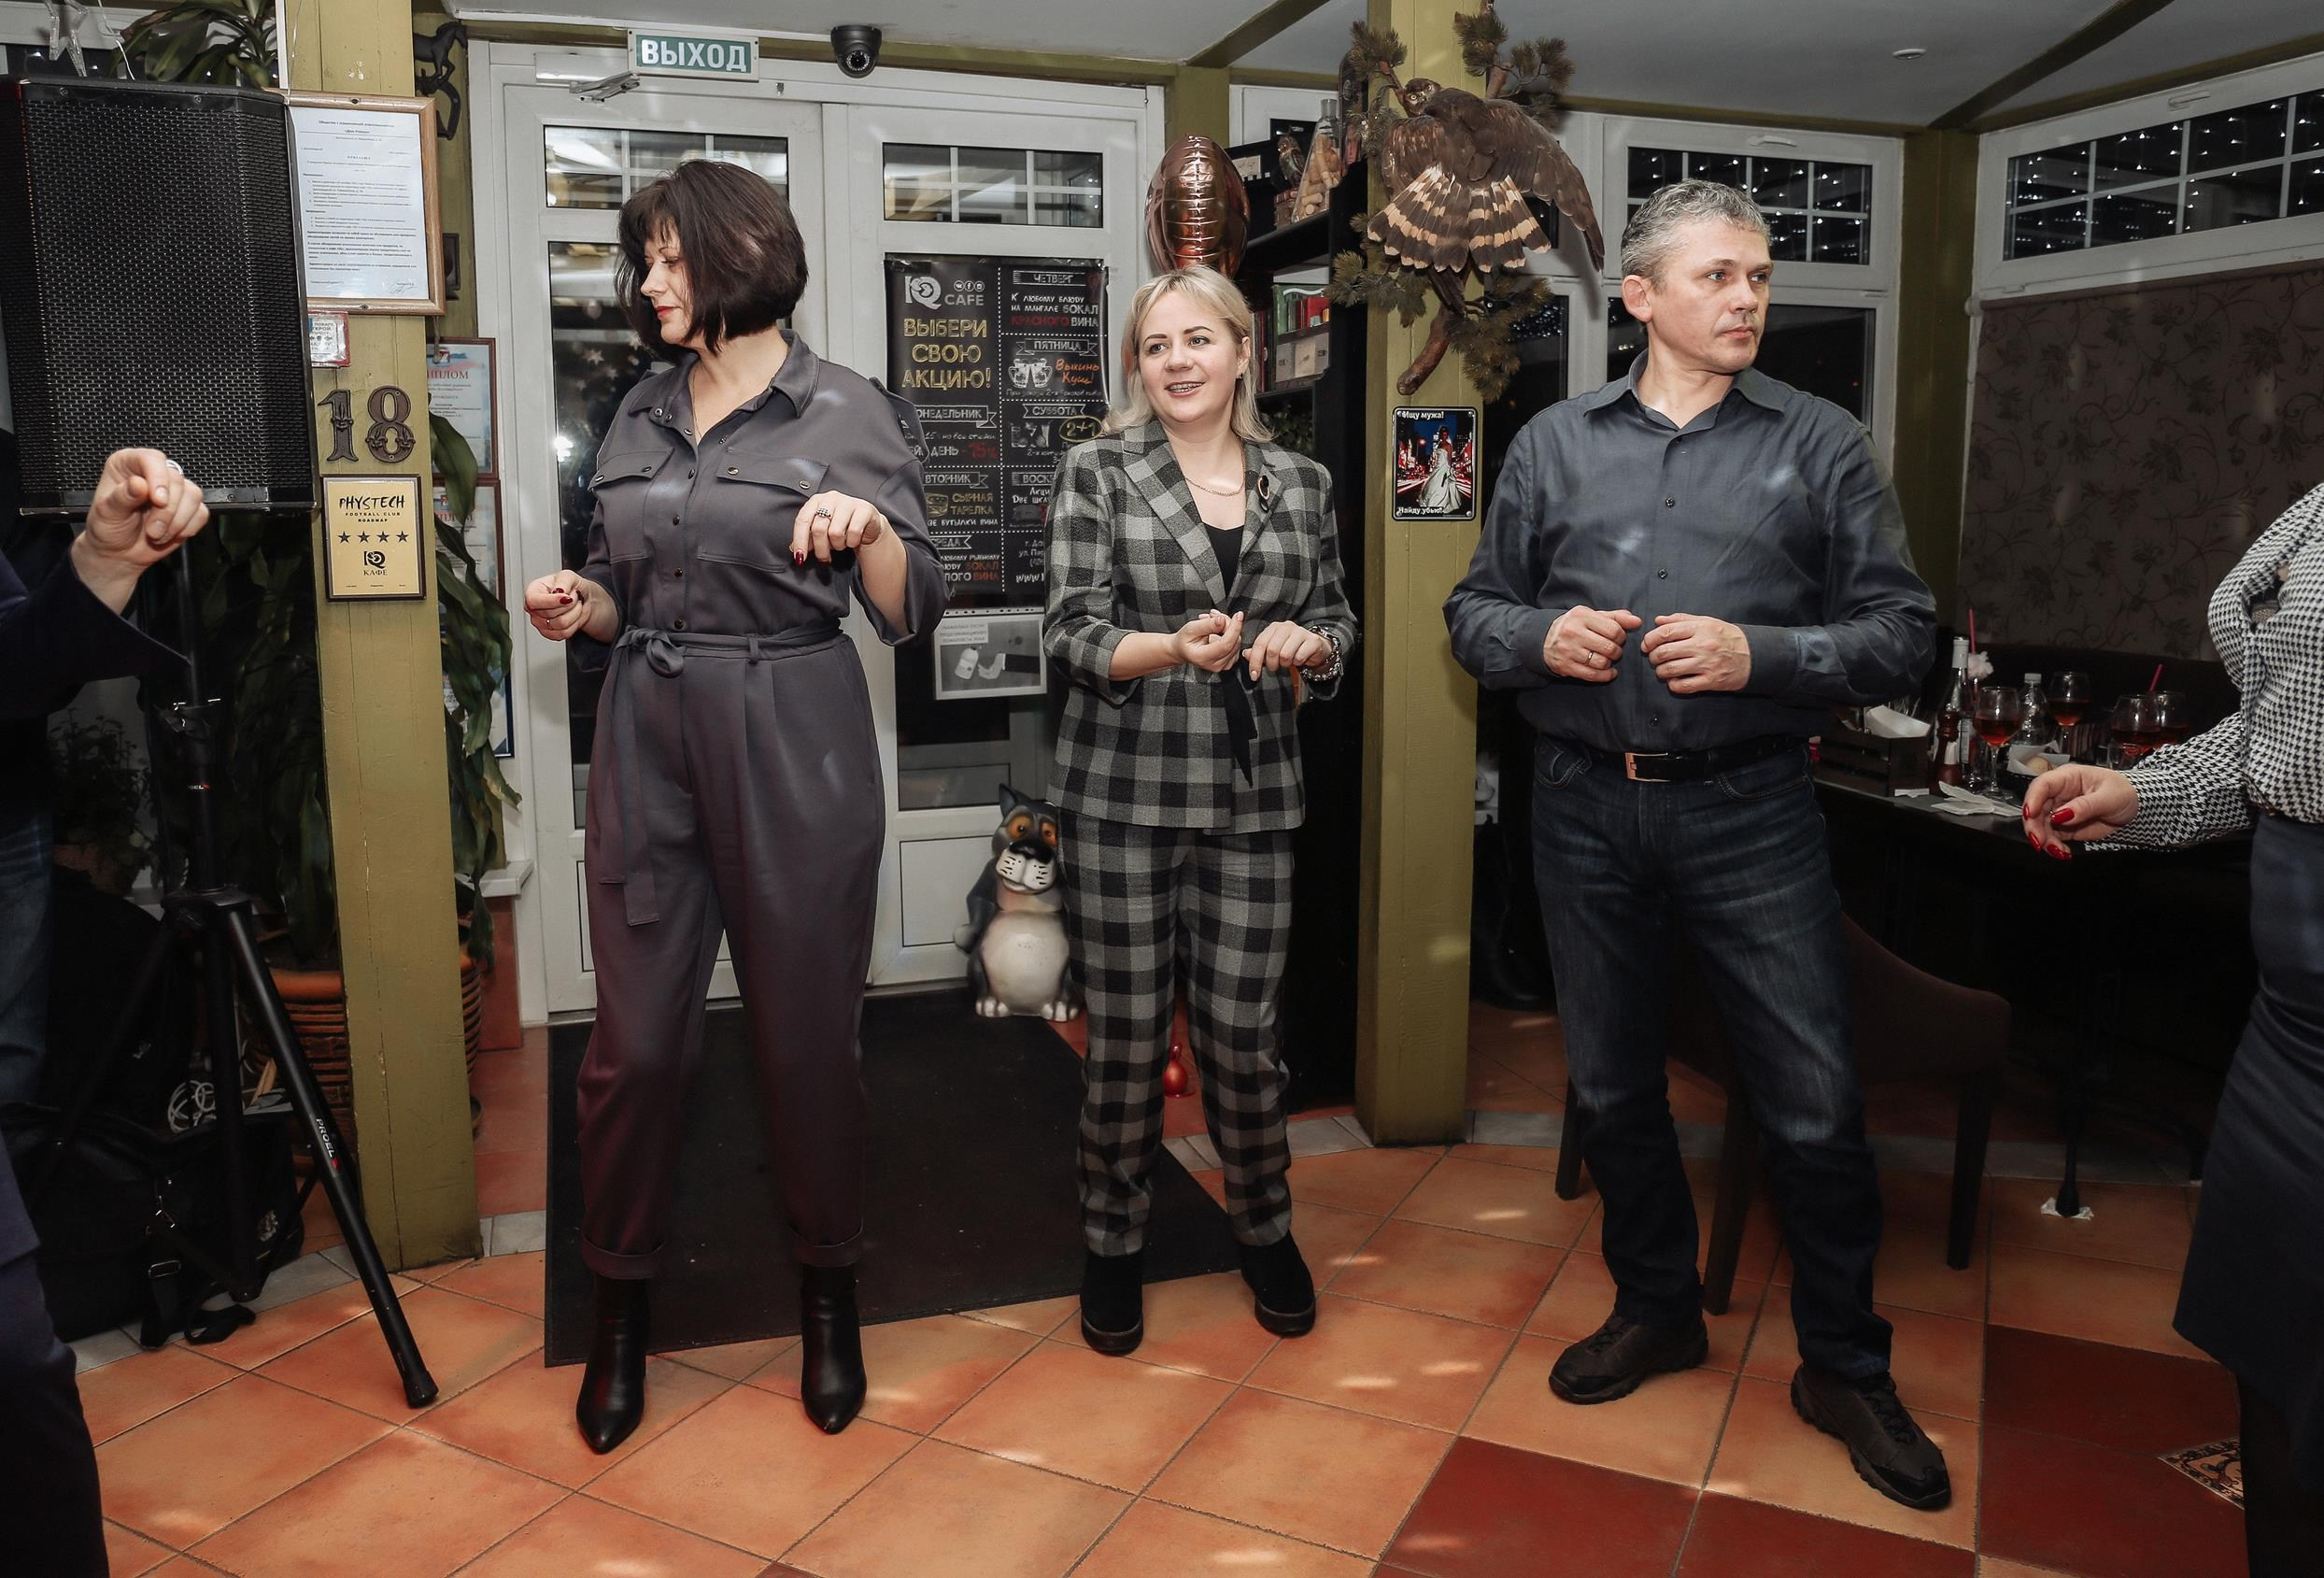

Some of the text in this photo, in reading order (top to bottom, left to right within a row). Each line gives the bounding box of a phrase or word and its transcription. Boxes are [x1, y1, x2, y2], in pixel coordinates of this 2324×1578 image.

[641, 38, 746, 73] ВЫХОД
[1033, 273, 1074, 284] ЧЕТВЕРГ
[904, 276, 942, 310] IQ
[944, 293, 985, 306] CAFE
[1062, 304, 1099, 315] БОКАЛ
[1070, 317, 1099, 327] ВИНА
[903, 318, 987, 338] ВЫБЕРИ
[1033, 340, 1082, 351] ПЯТНИЦА
[912, 343, 982, 363] СВОЮ
[427, 370, 469, 379] ИПЛОМ
[901, 367, 991, 391] АКЦИЮ!
[916, 409, 983, 419] ОНЕДЕЛЬНИК
[1032, 406, 1077, 416] СУББОТА
[1402, 410, 1444, 420] Ищу мужа!
[318, 385, 417, 464] 18
[930, 446, 959, 457] ДЕНЬ
[925, 474, 971, 484] ВТОРНИК
[339, 495, 404, 510] PHYSTECH
[953, 493, 994, 502] СЫРНАЯ
[950, 505, 994, 515] ТАРЕЛКА
[363, 550, 387, 569] IQ
[316, 1118, 334, 1158] PROEL
